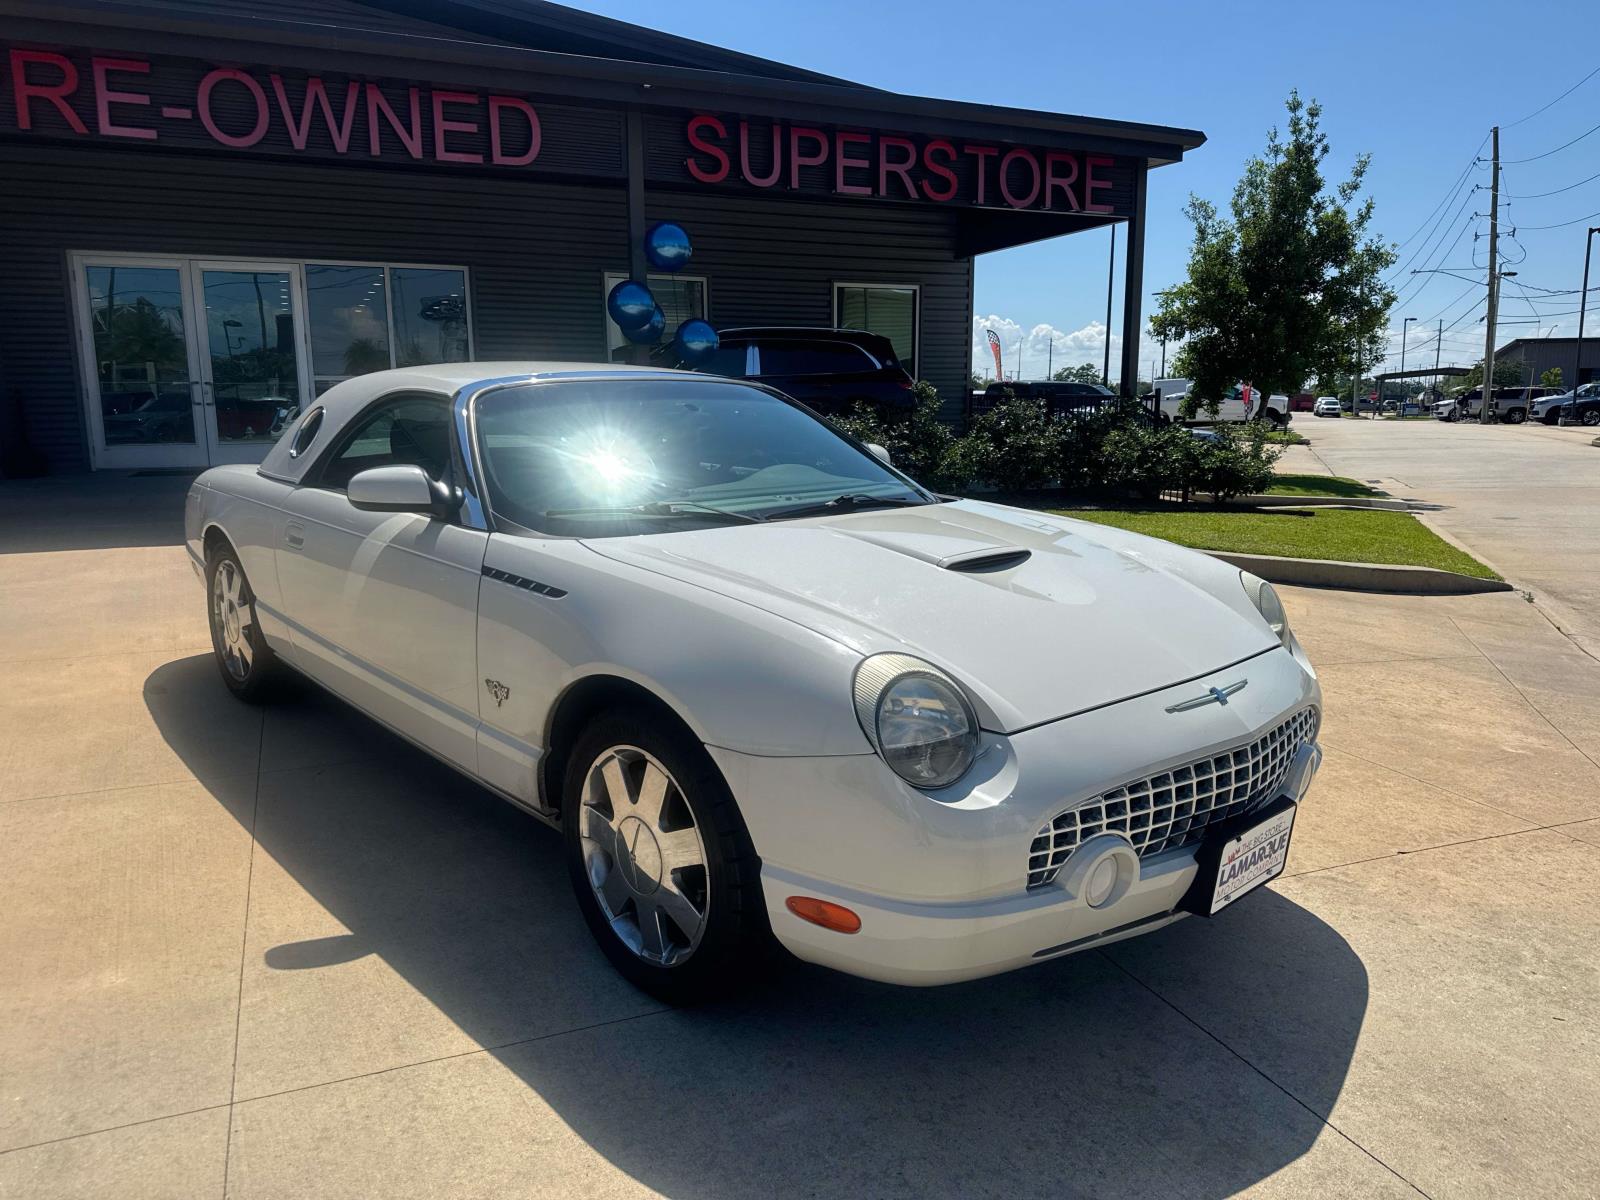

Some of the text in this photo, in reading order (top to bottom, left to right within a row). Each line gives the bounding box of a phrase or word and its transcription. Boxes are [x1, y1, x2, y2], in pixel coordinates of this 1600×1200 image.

[9, 48, 1115, 214] RE-OWNED SUPERSTORE
[1216, 873, 1246, 898] MOTOR
[1219, 832, 1288, 887] LAMARQUE
